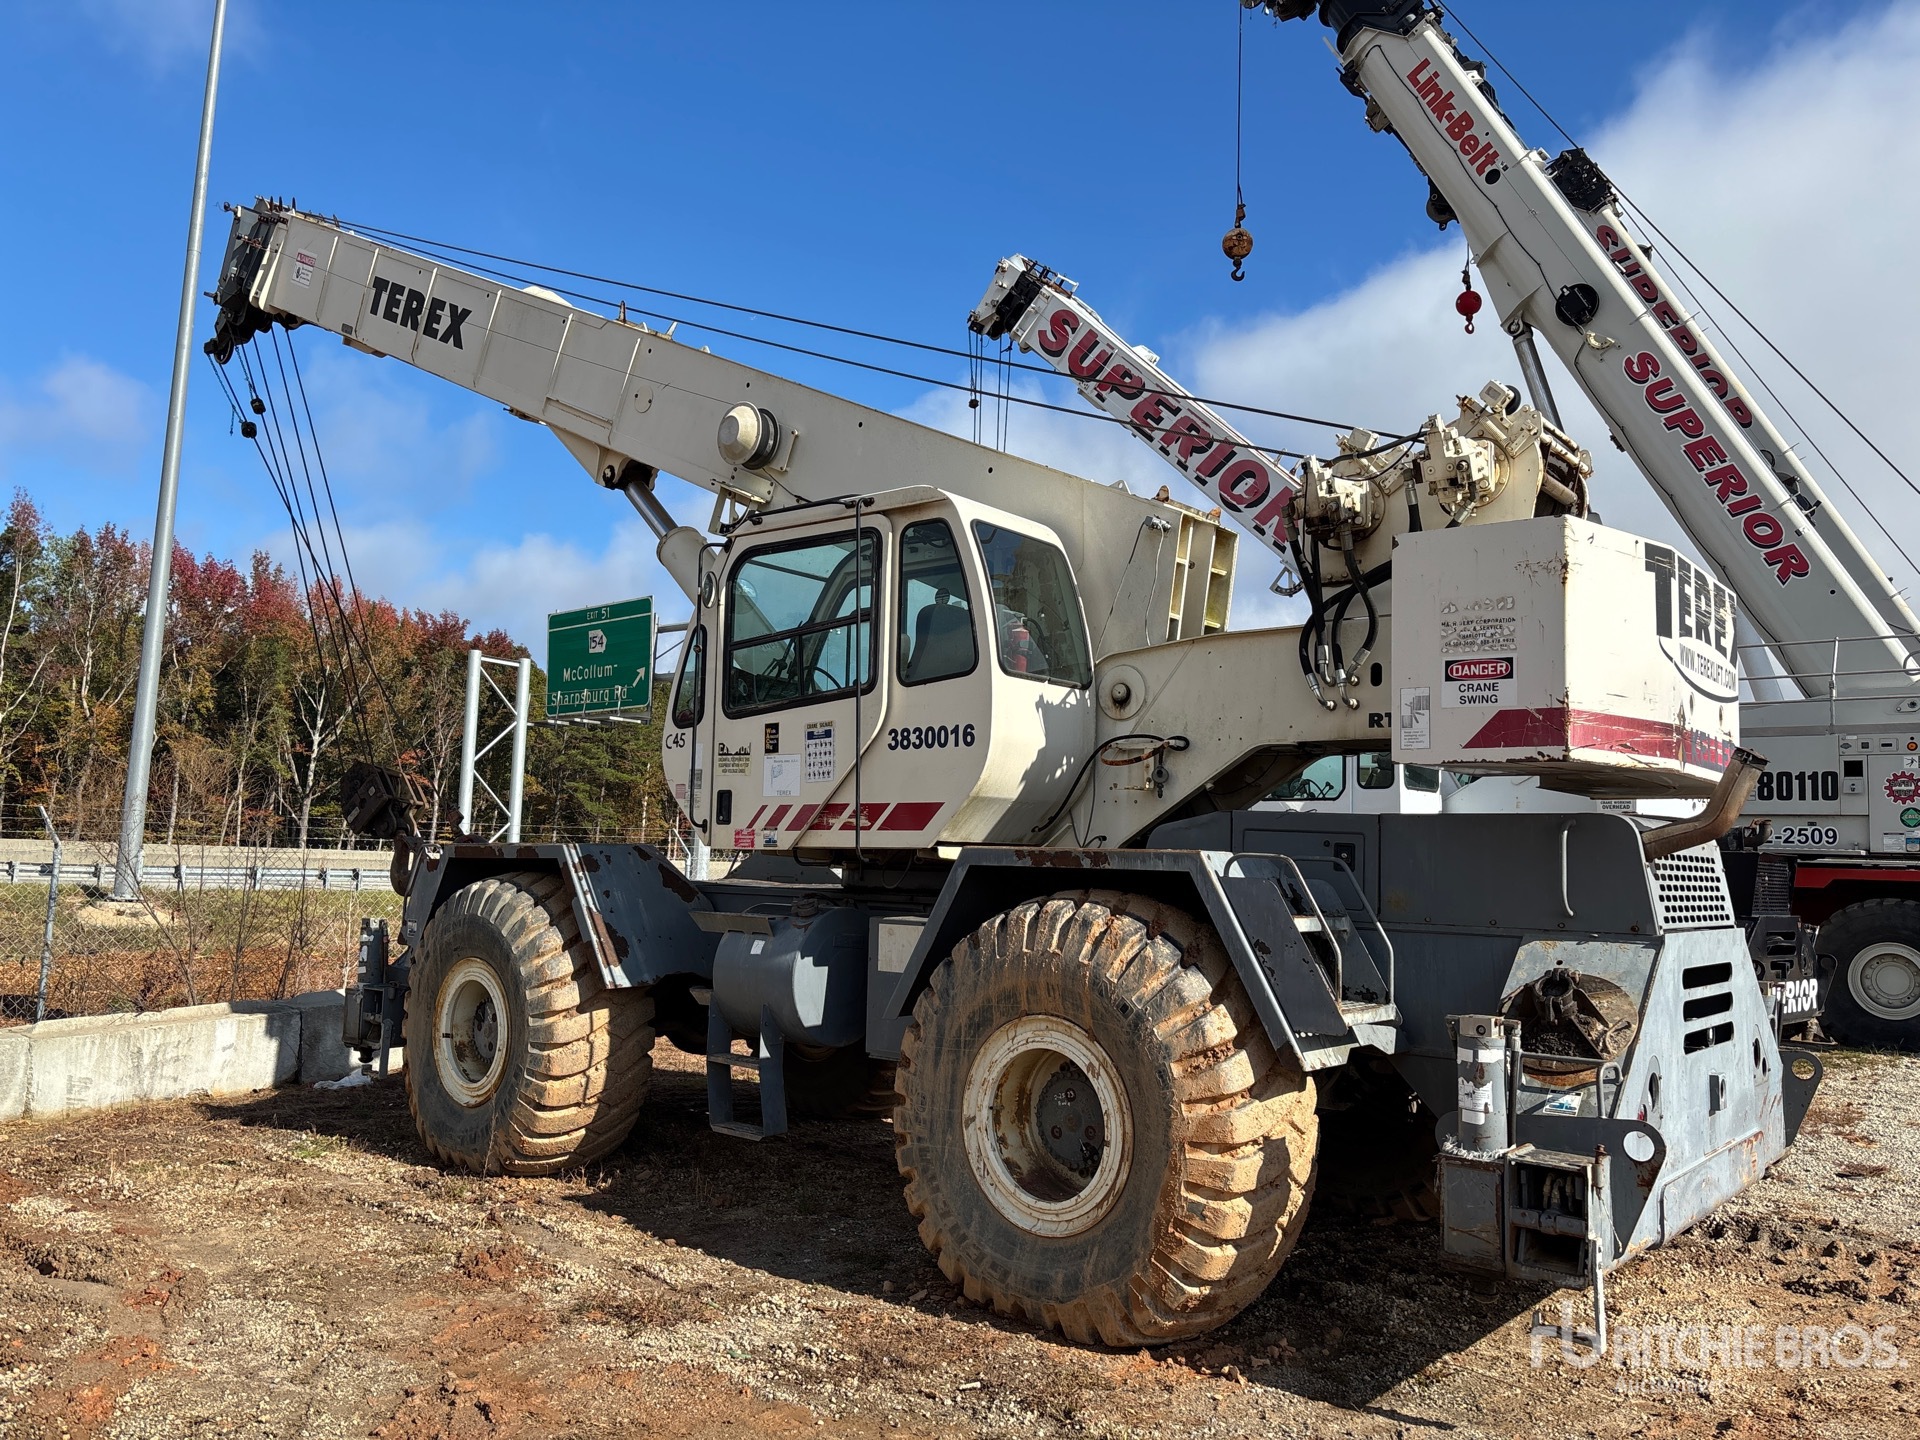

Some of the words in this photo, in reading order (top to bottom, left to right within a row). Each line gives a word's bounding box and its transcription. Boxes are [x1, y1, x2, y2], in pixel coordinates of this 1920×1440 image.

[1407, 58, 1499, 177] Link-Belt
[370, 276, 472, 350] TEREX
[1622, 352, 1810, 586] SUPERIOR
[587, 611, 598, 620] EXIT
[601, 607, 610, 619] 51
[589, 635, 604, 649] 154
[1452, 663, 1507, 676] DANGER
[551, 689, 609, 706] Sharpsburg
[614, 684, 627, 699] Rd
[1458, 682, 1499, 693] CRANE
[1459, 694, 1498, 704] SWING
[887, 723, 976, 751] 3830016
[1765, 827, 1838, 845] -2509
